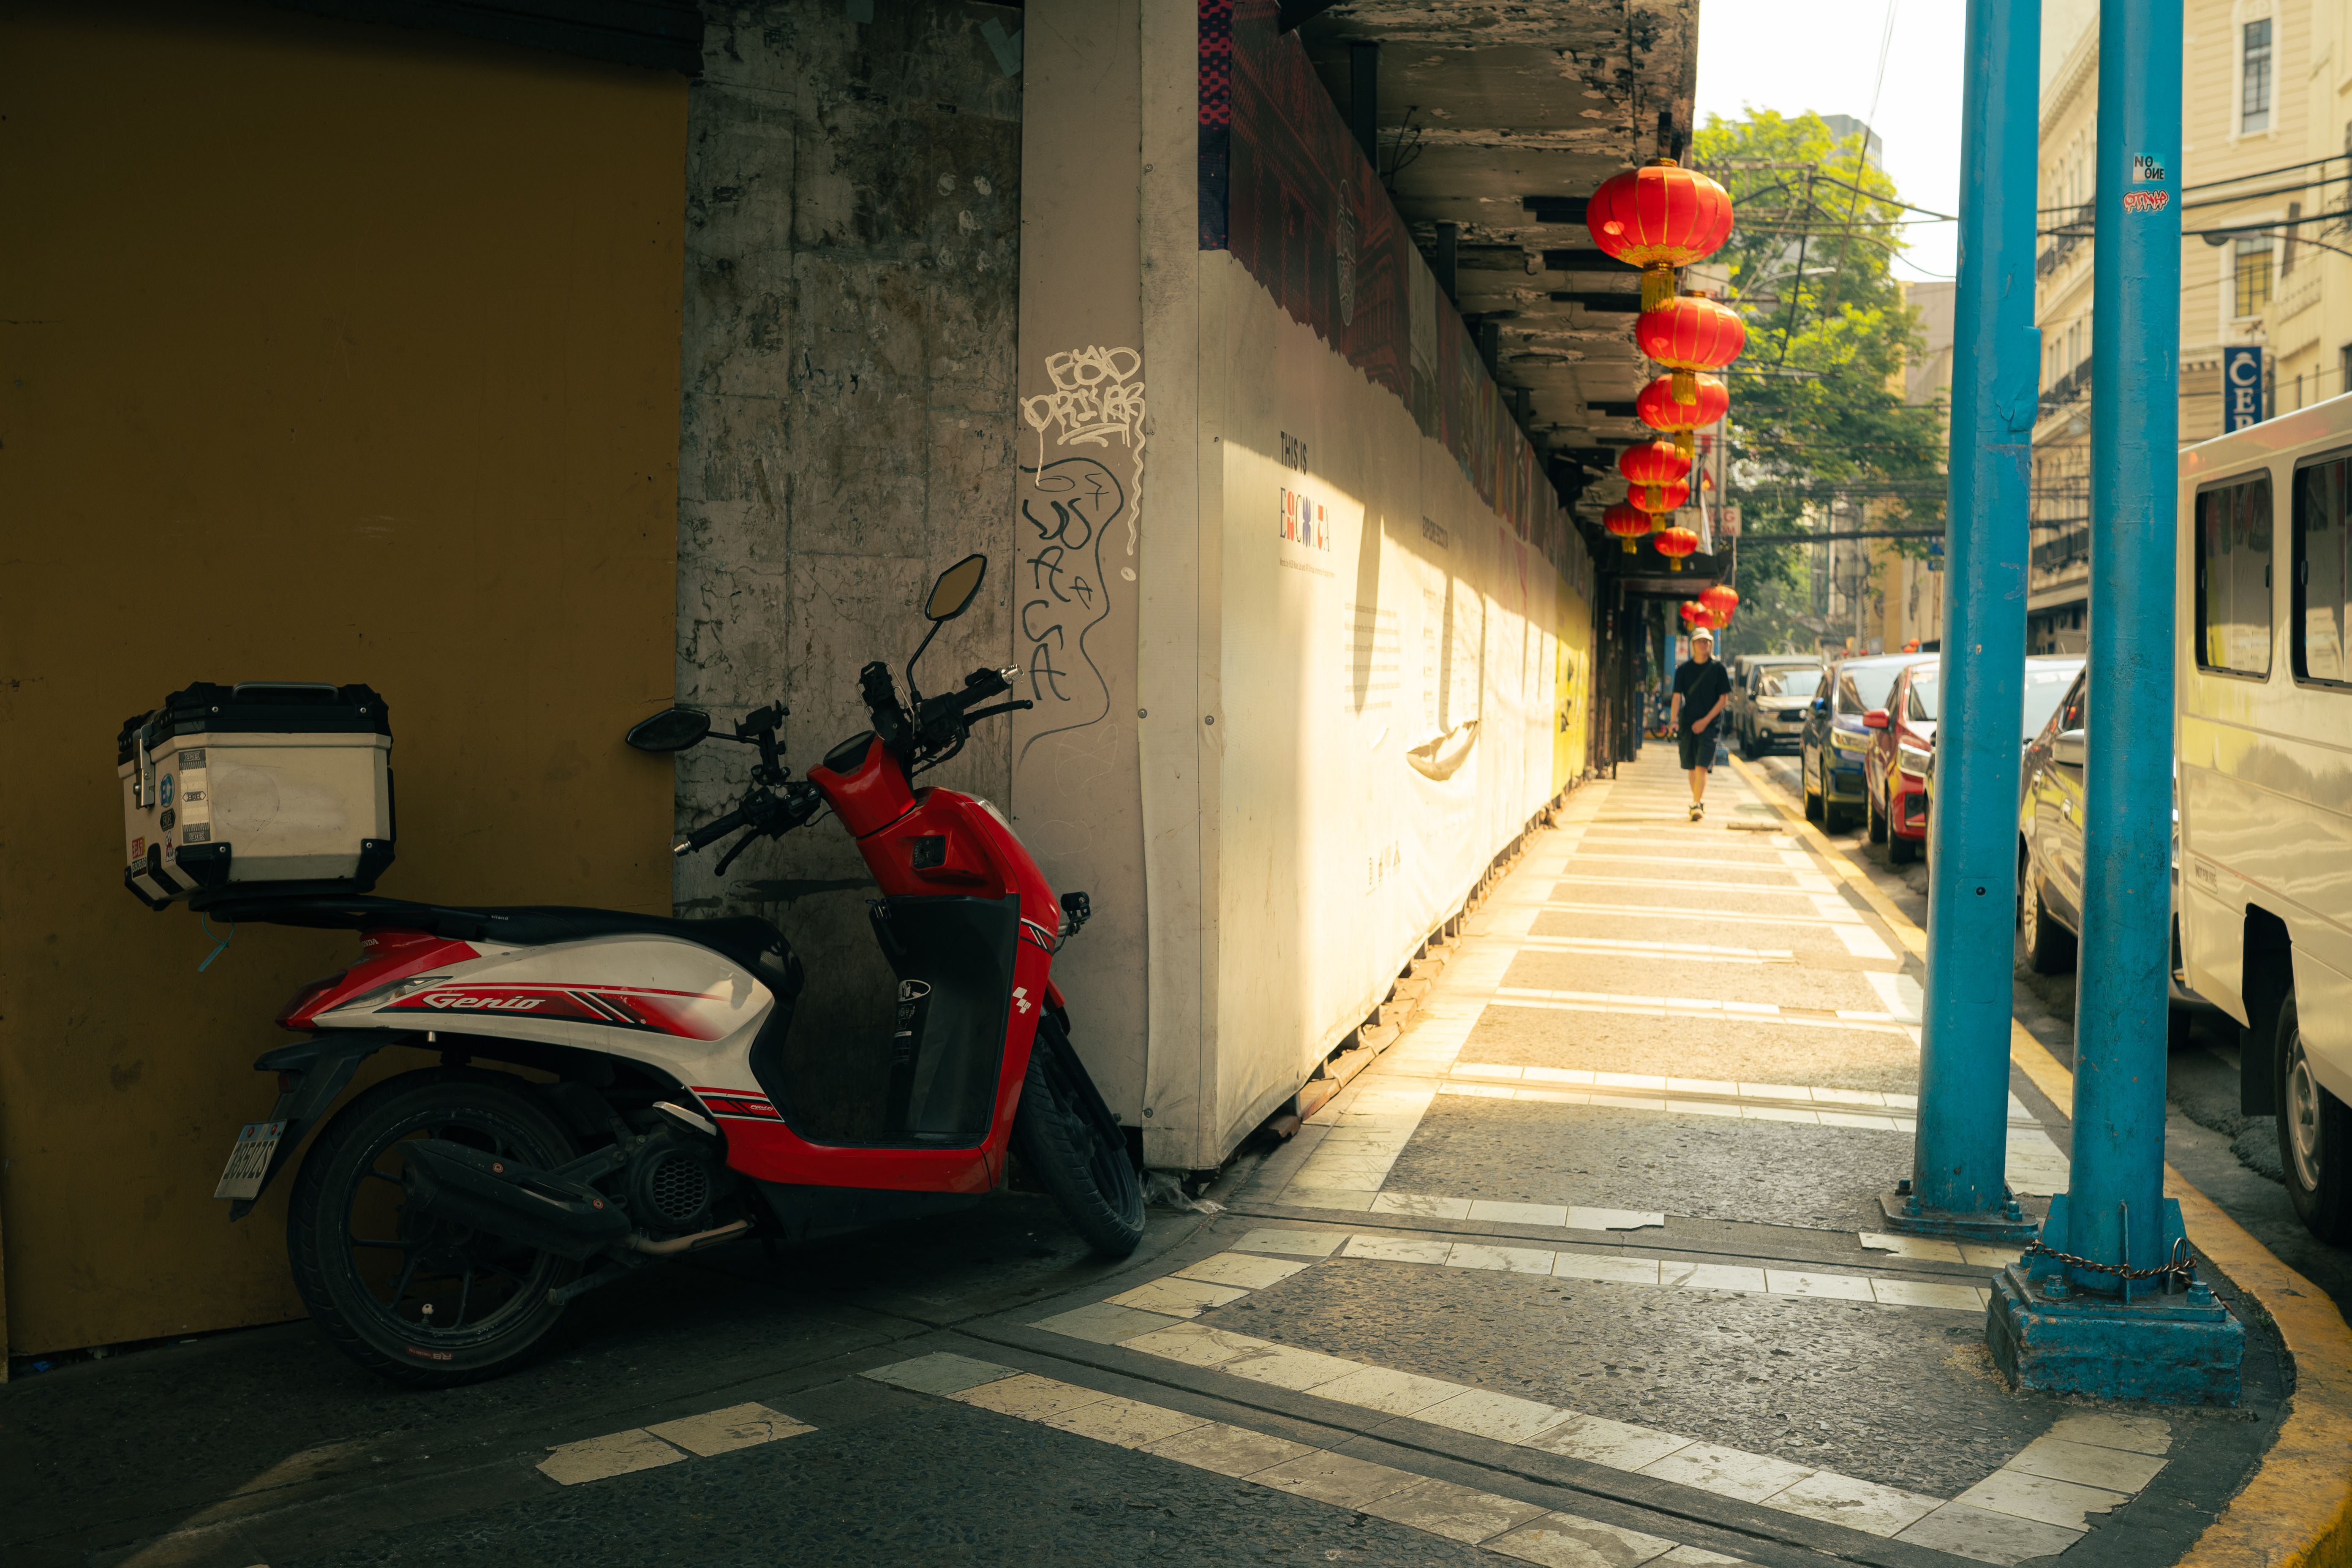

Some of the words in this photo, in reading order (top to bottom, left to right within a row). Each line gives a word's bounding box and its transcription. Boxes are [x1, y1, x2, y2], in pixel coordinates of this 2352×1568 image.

[2135, 156, 2153, 167] NO
[1281, 430, 1298, 471] THIS
[1301, 441, 1307, 475] IS
[2209, 871, 2217, 887] HIRE
[362, 938, 379, 947] ONDA
[423, 993, 546, 1010] Genio
